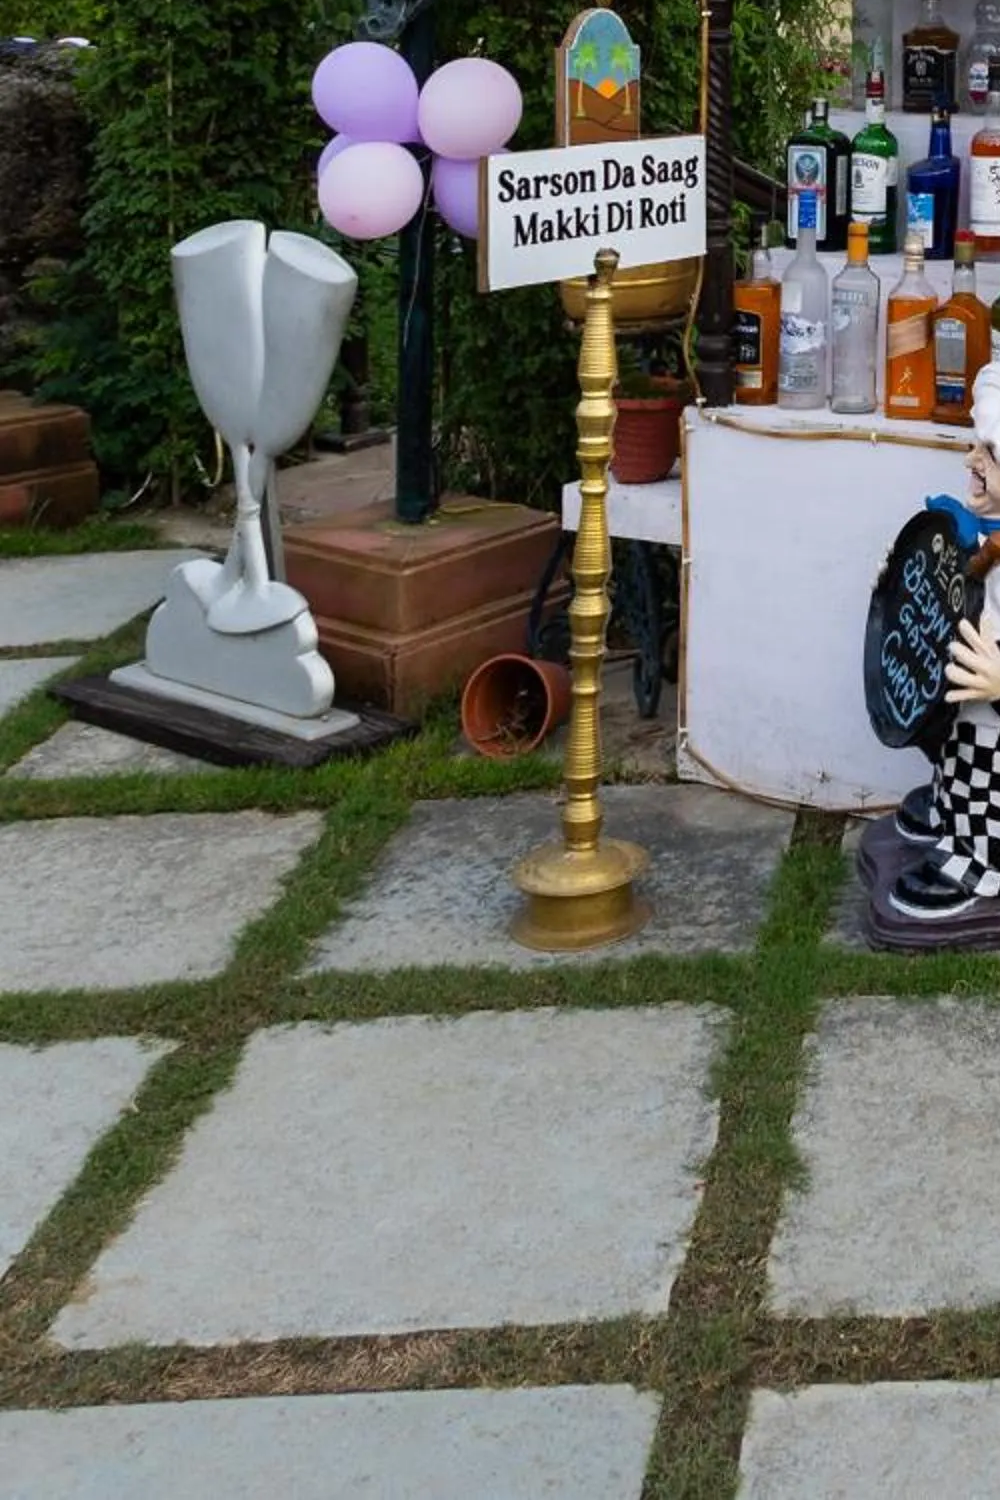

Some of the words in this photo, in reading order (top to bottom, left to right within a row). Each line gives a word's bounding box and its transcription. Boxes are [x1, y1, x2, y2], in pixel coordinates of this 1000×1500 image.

[498, 169, 596, 203] Sarson
[602, 159, 636, 190] Da
[641, 155, 699, 189] Saag
[513, 205, 600, 248] Makki
[606, 201, 634, 233] Di
[639, 193, 687, 228] Roti
[904, 549, 951, 642] BESAN
[881, 630, 928, 729] CURRY
